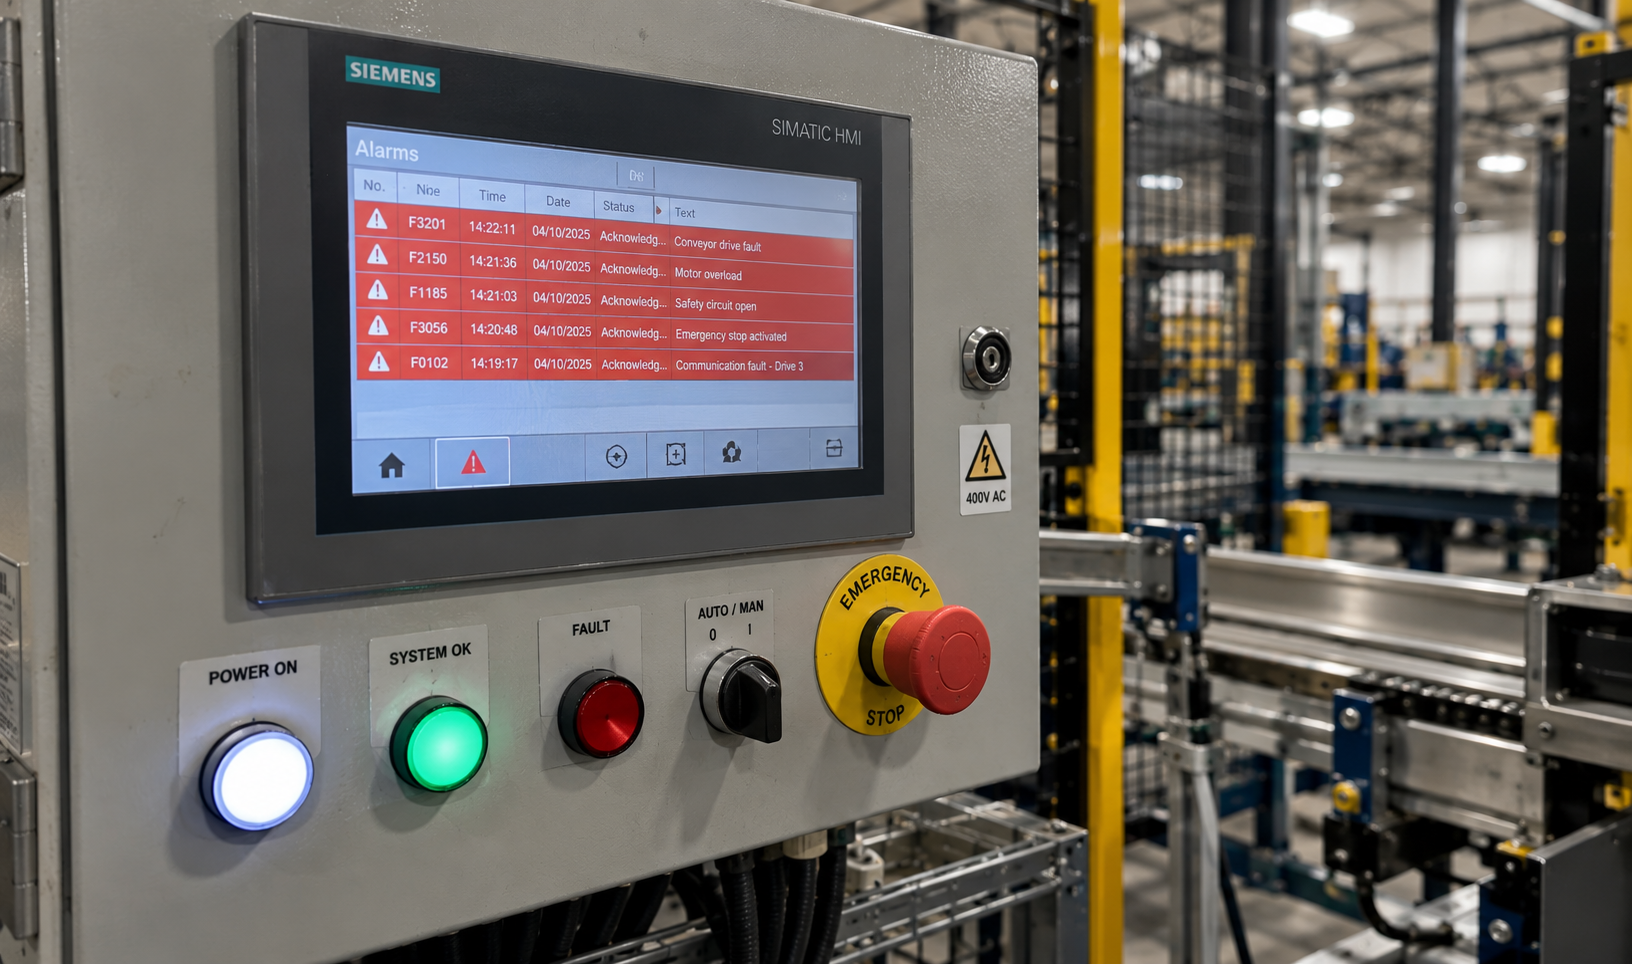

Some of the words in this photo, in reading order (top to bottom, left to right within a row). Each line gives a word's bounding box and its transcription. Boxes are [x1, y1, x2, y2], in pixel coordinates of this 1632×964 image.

[350, 62, 436, 88] SIEMENS
[772, 118, 831, 142] SIMATIC
[835, 127, 862, 146] HMI
[354, 139, 419, 162] Alarms
[363, 179, 386, 192] No.
[479, 189, 506, 203] Time
[546, 195, 571, 208] Date
[603, 200, 635, 214] Status
[675, 207, 696, 219] Text
[408, 216, 446, 230] F3201
[469, 221, 516, 235] 14:22:11
[532, 225, 591, 240] 04/10/2025
[600, 231, 666, 247] Acknowledg...
[674, 236, 717, 251] Conveyor
[720, 239, 741, 251] drive
[743, 242, 762, 253] fault
[409, 251, 447, 265] F2150
[469, 255, 517, 269] 14:21:36
[532, 258, 591, 273] 04/10/2025
[600, 263, 666, 278] Acknowledg...
[675, 267, 702, 279] Motor
[704, 270, 742, 281] overload
[409, 286, 448, 299] F1185
[470, 289, 518, 302] 14:21:03
[533, 291, 591, 305] 04/10/2025
[601, 295, 667, 309] Acknowledg...
[675, 298, 704, 312] Safety
[706, 300, 733, 311] circuit
[735, 302, 757, 314] open
[410, 321, 448, 334] F3056
[470, 324, 518, 336] 14:20:48
[533, 325, 592, 338] 04/10/2025
[601, 327, 667, 341] Acknowledg...
[675, 329, 726, 343] Emergency
[728, 331, 748, 343] stop
[749, 331, 787, 342] activated
[411, 357, 448, 369] F0102
[471, 358, 518, 369] 14:19:17
[534, 358, 592, 370] 04/10/2025
[602, 359, 667, 372] Acknowledg...
[676, 360, 746, 371] Communication
[747, 360, 767, 371] fault
[775, 361, 796, 371] Drive
[798, 361, 804, 371] 3
[966, 491, 990, 504] 400V
[992, 489, 1006, 502] AC
[839, 565, 930, 611] EMERGENCY
[698, 604, 729, 619] AUTO
[731, 603, 737, 615] /
[739, 599, 764, 614] MAN
[572, 619, 611, 636] FAULT
[389, 645, 448, 666] SYSTEM
[451, 642, 472, 657] OK
[209, 664, 269, 686] POWER
[274, 660, 298, 676] ON
[866, 704, 905, 727] STOP
